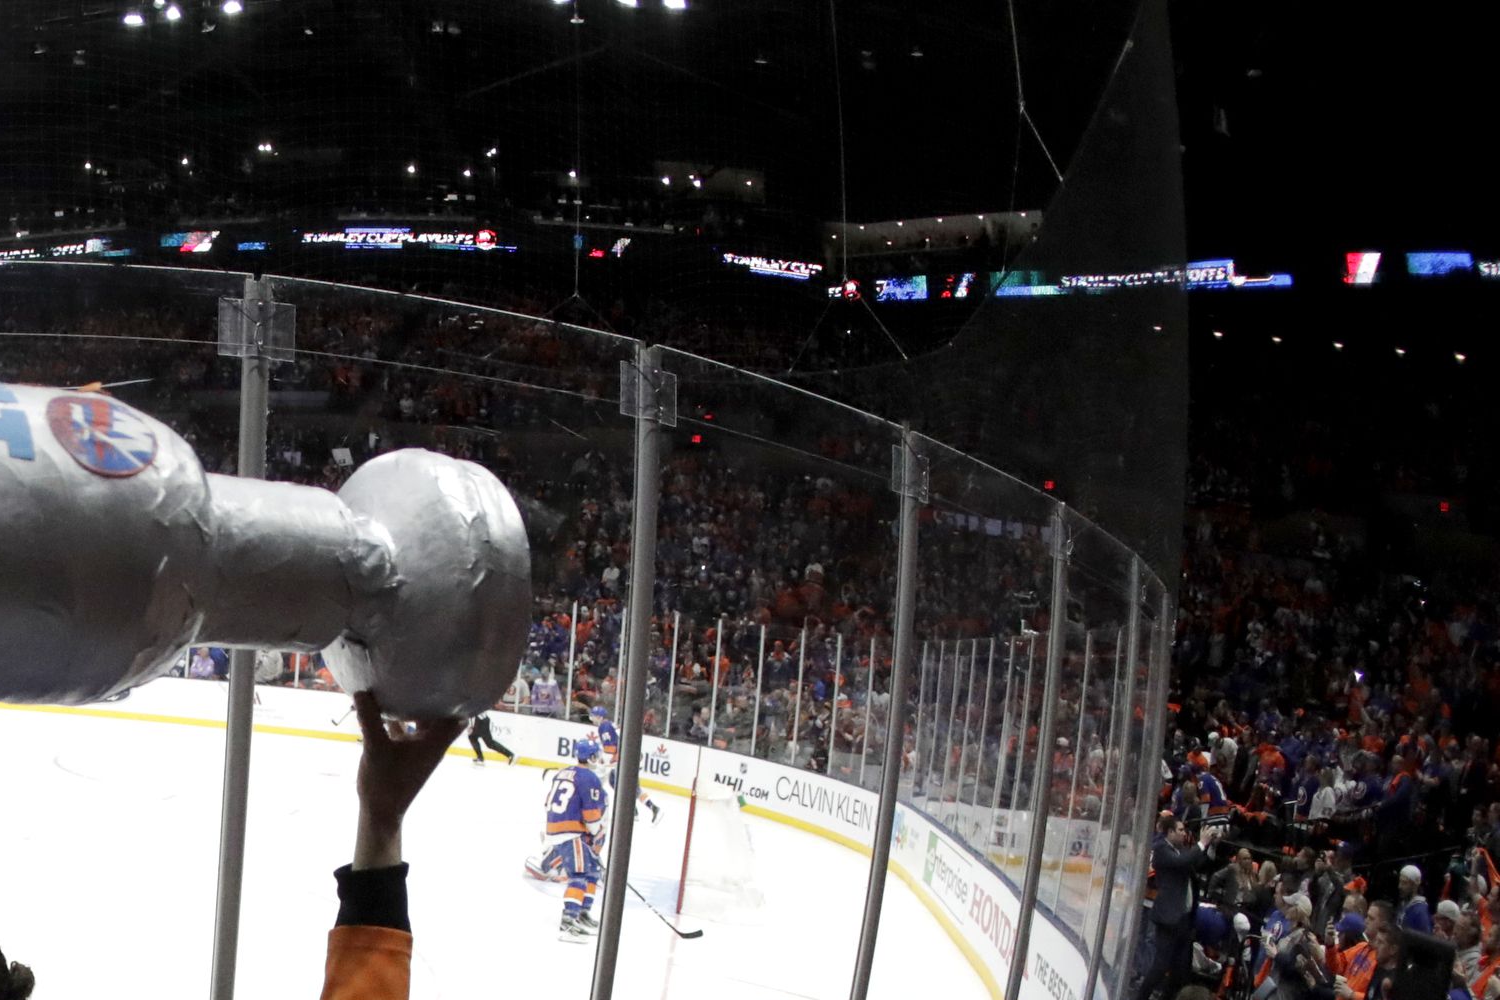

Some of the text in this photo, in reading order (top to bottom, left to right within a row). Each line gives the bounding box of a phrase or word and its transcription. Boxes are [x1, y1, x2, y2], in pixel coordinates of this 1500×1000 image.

[302, 232, 366, 244] STANLEY
[367, 232, 398, 244] CUP
[638, 751, 672, 777] lue
[544, 781, 577, 815] 13
[775, 775, 832, 816] CALVIN
[836, 793, 874, 832] KLEIN
[926, 847, 968, 905] enterprise
[1033, 952, 1050, 987] THE
